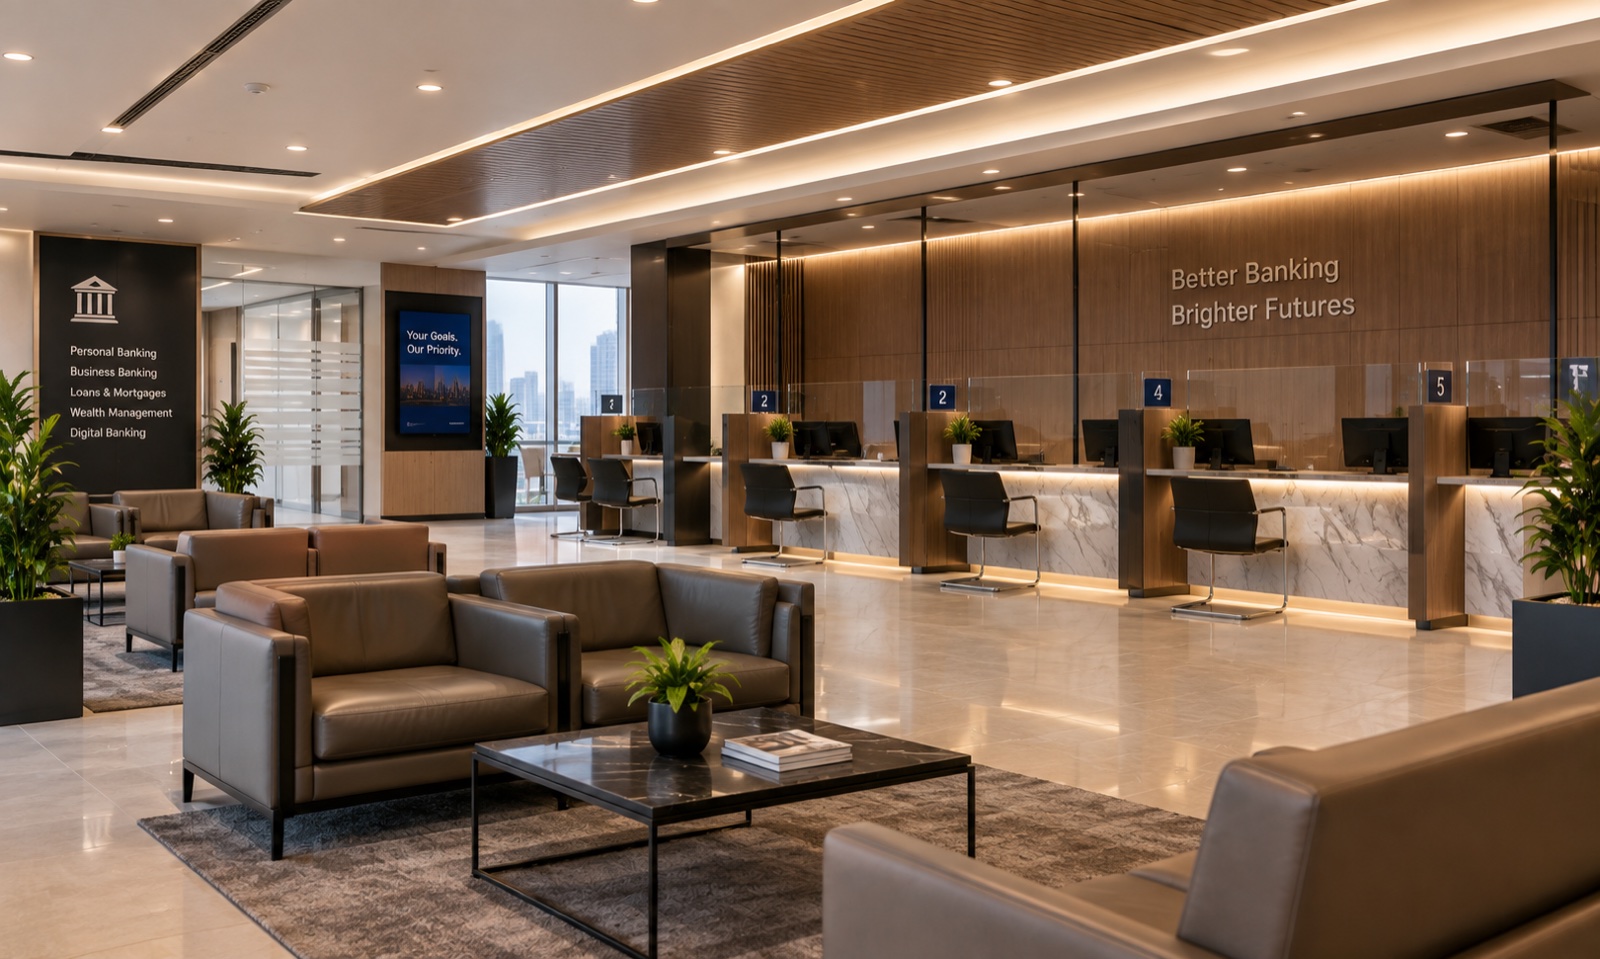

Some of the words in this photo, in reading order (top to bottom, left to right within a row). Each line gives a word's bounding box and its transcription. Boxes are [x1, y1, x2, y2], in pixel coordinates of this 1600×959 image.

[1172, 267, 1238, 290] Better
[1245, 257, 1339, 283] Banking
[1172, 301, 1258, 329] Brighter
[1265, 297, 1355, 320] Futures
[406, 330, 428, 340] Your
[430, 331, 458, 342] Goals.
[70, 345, 114, 357] Personal
[117, 347, 157, 361] Banking
[407, 344, 424, 354] Our
[426, 344, 461, 357] Priority.
[70, 366, 115, 377] Business
[118, 367, 157, 380] Banking
[70, 387, 100, 398] Loans
[103, 387, 111, 398] &
[113, 387, 167, 400] Mortgages
[1153, 384, 1163, 401] 4
[1437, 376, 1445, 397] 5
[761, 394, 768, 408] 2
[938, 390, 947, 405] 2
[69, 407, 106, 418] Wealth
[108, 407, 173, 420] Management
[70, 427, 103, 440] Digital
[106, 427, 147, 440] Banking
